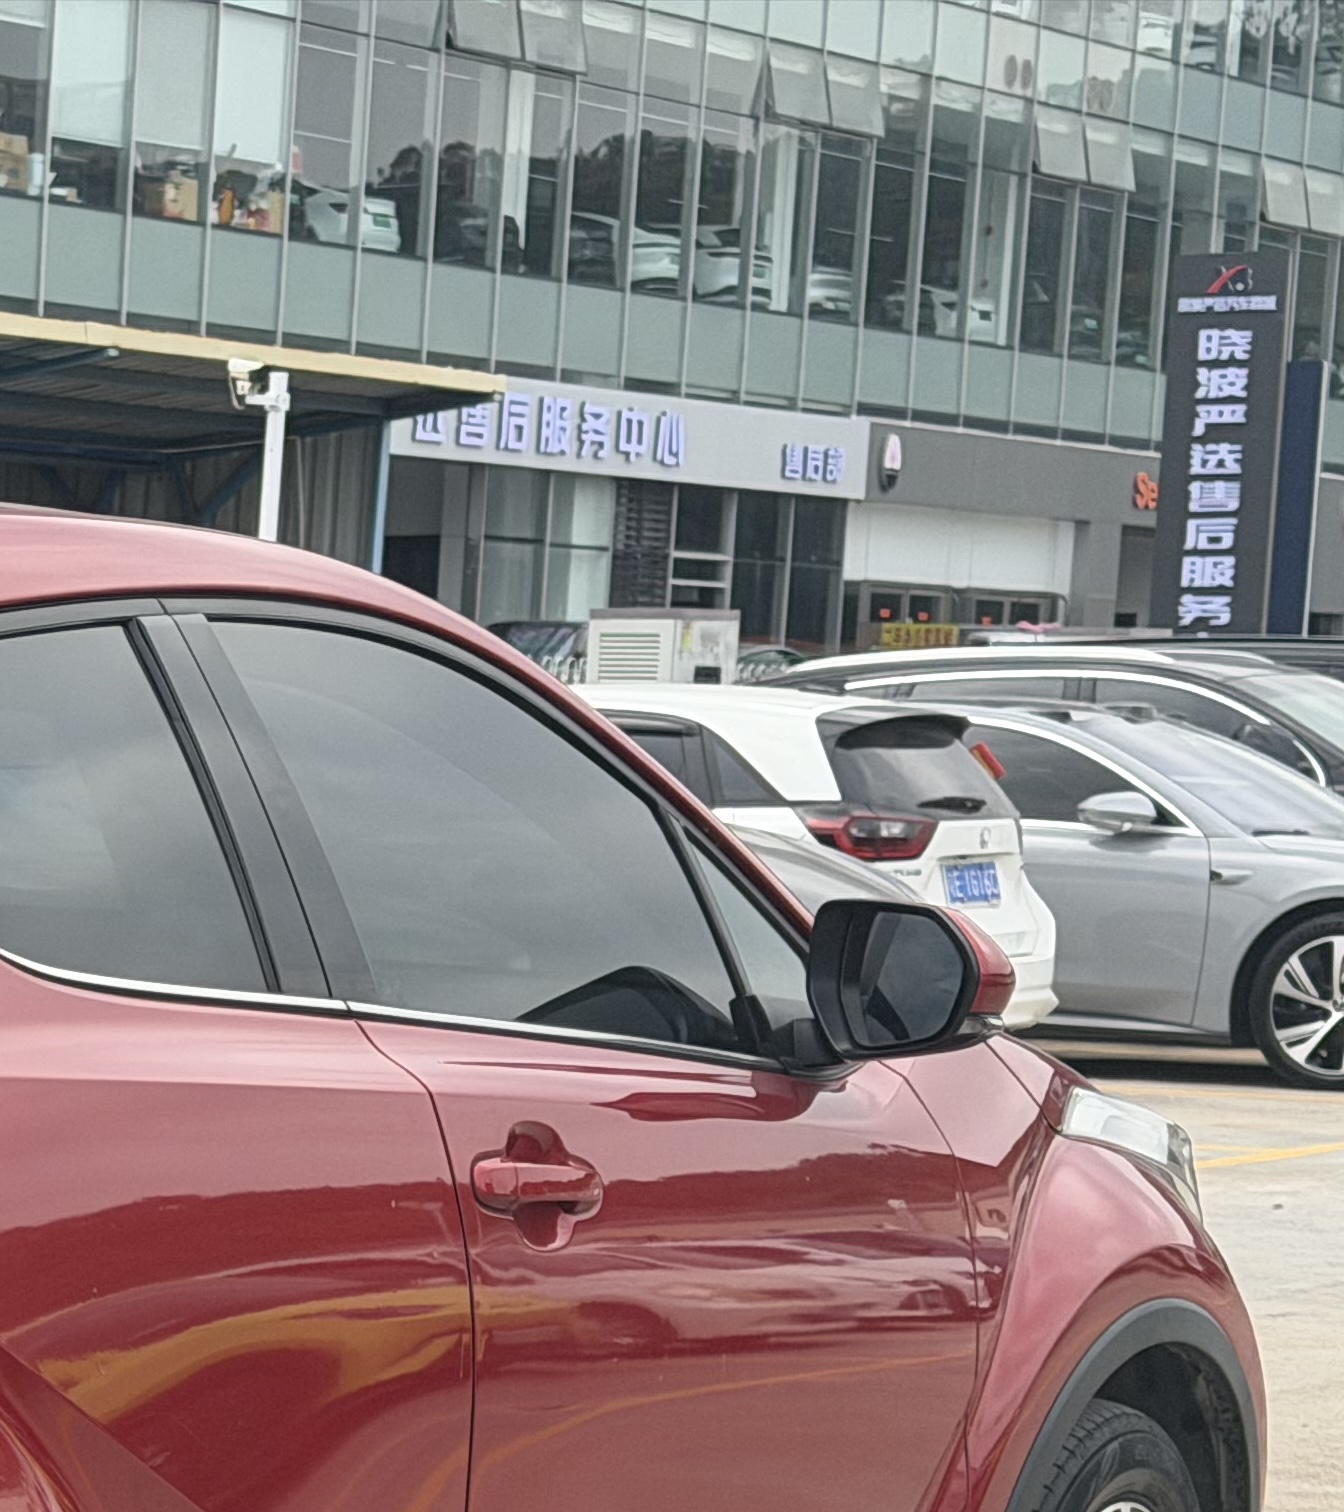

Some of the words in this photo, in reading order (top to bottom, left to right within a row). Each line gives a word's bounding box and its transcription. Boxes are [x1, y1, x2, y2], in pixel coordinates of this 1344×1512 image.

[1178, 327, 1253, 638] 晓波严选售后服务
